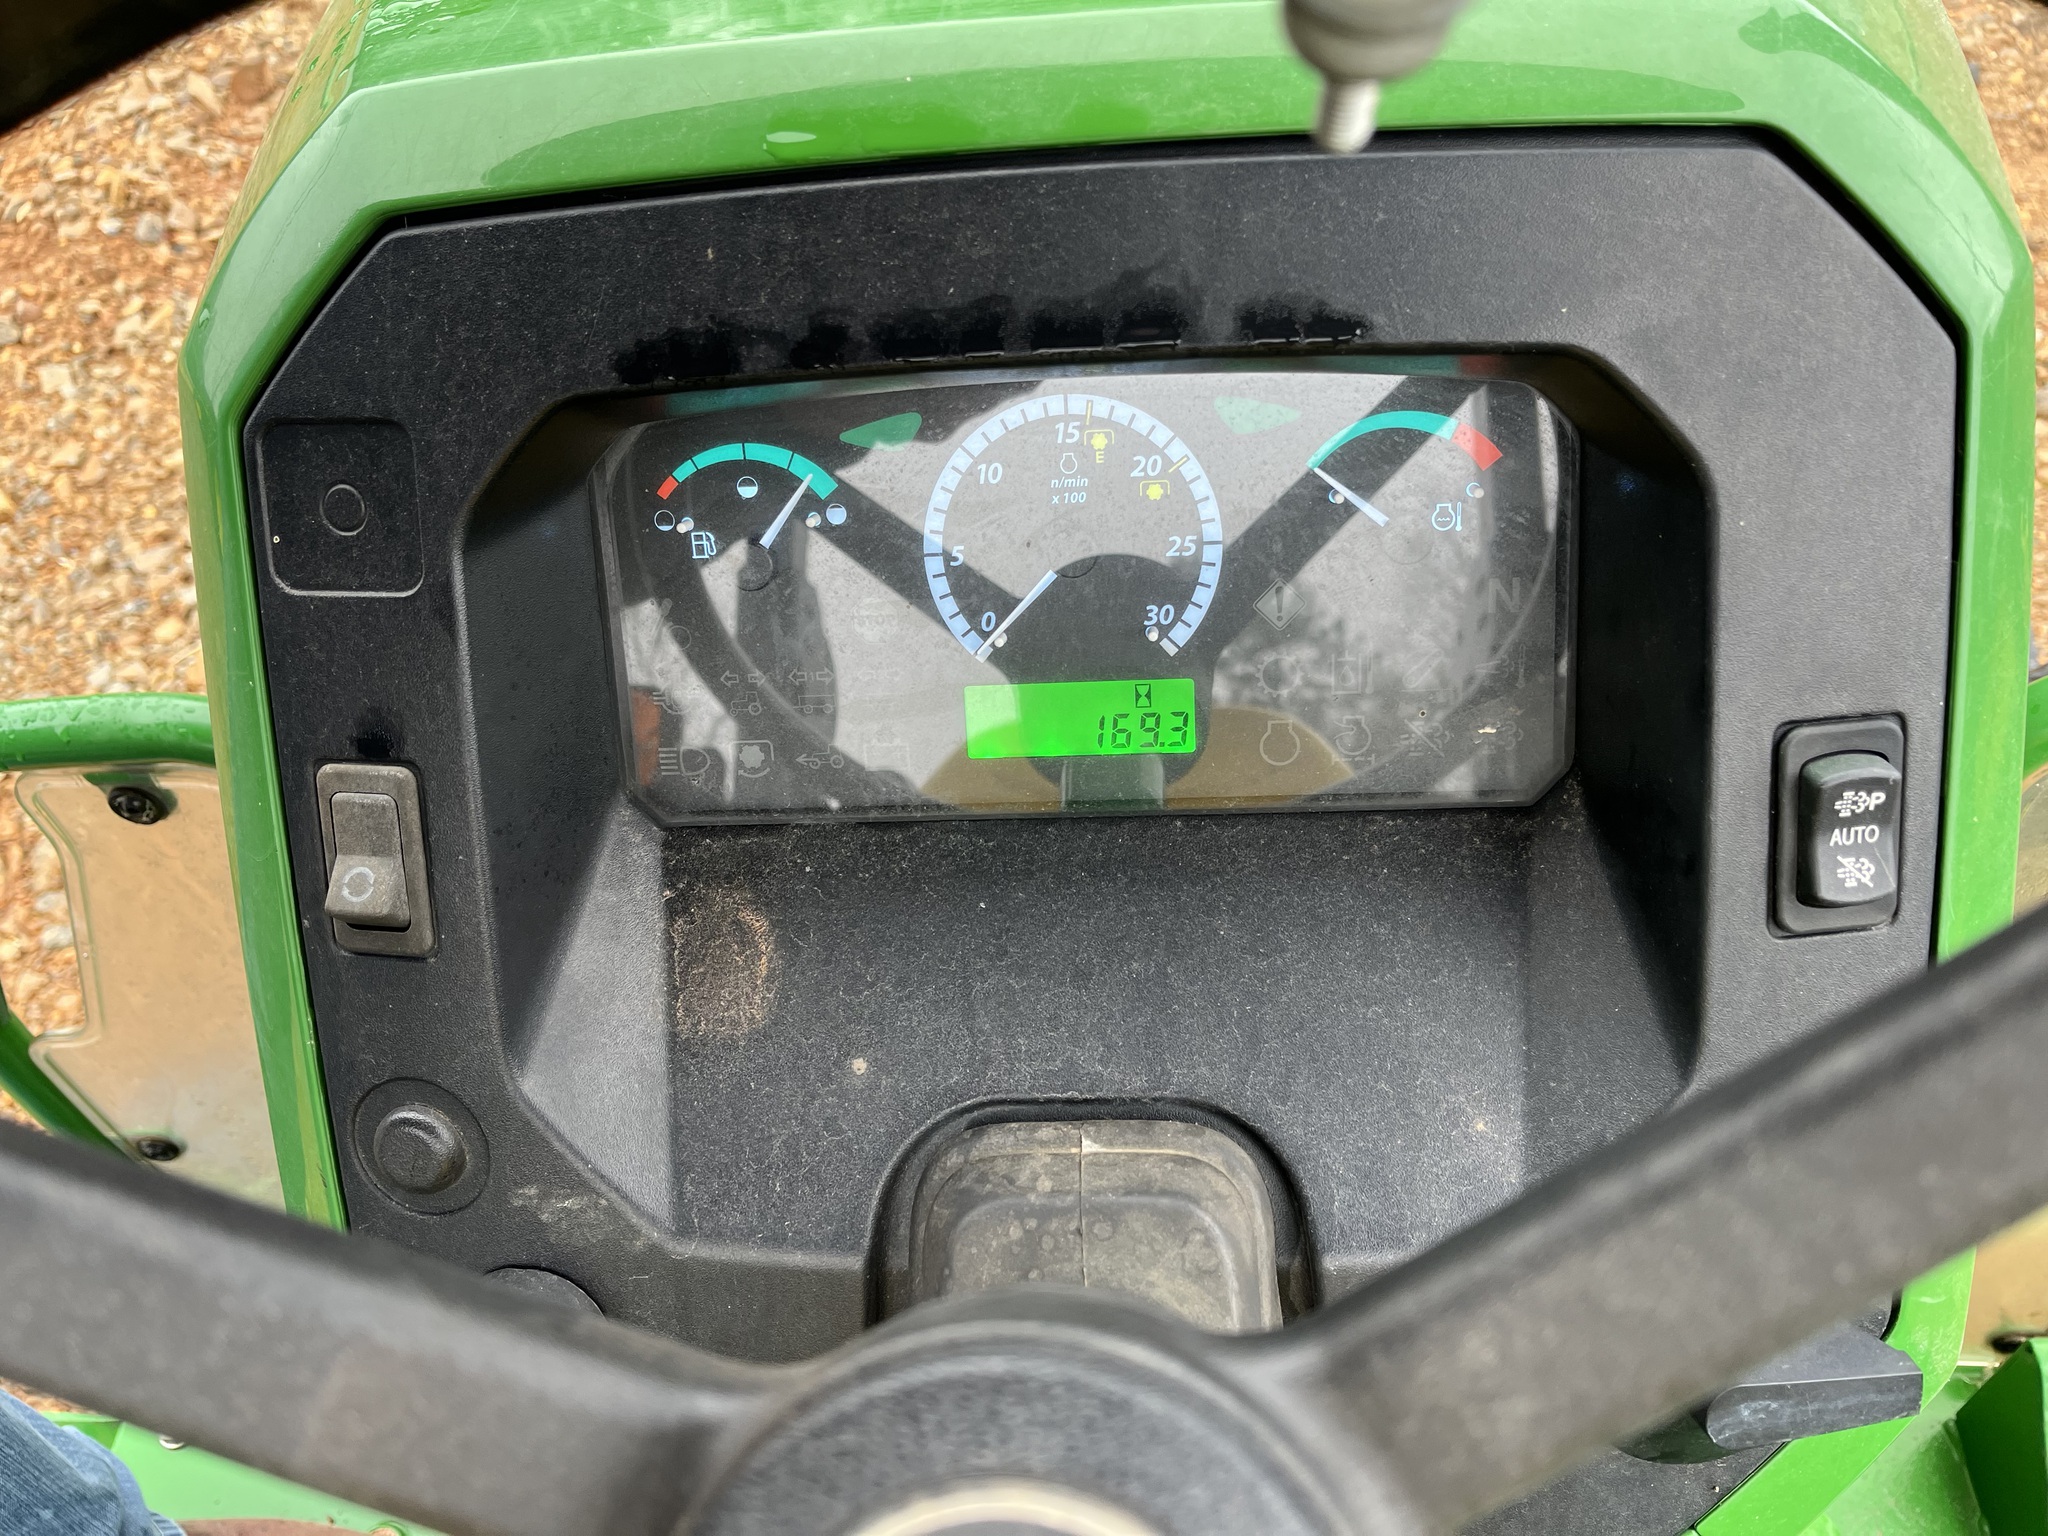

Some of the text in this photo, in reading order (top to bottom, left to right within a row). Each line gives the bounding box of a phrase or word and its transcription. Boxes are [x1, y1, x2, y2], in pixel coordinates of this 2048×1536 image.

[1054, 421, 1081, 444] 15
[1095, 450, 1105, 464] E
[1130, 454, 1163, 477] 20
[976, 462, 1003, 484] 10
[1050, 476, 1089, 488] n/min
[1063, 491, 1087, 504] 100
[949, 545, 965, 567] 5
[1165, 535, 1197, 557] 25
[980, 611, 996, 632] 0
[1143, 604, 1175, 625] 30
[1097, 711, 1189, 749] 169.3
[1868, 791, 1887, 811] P
[1829, 824, 1880, 847] AUTO
